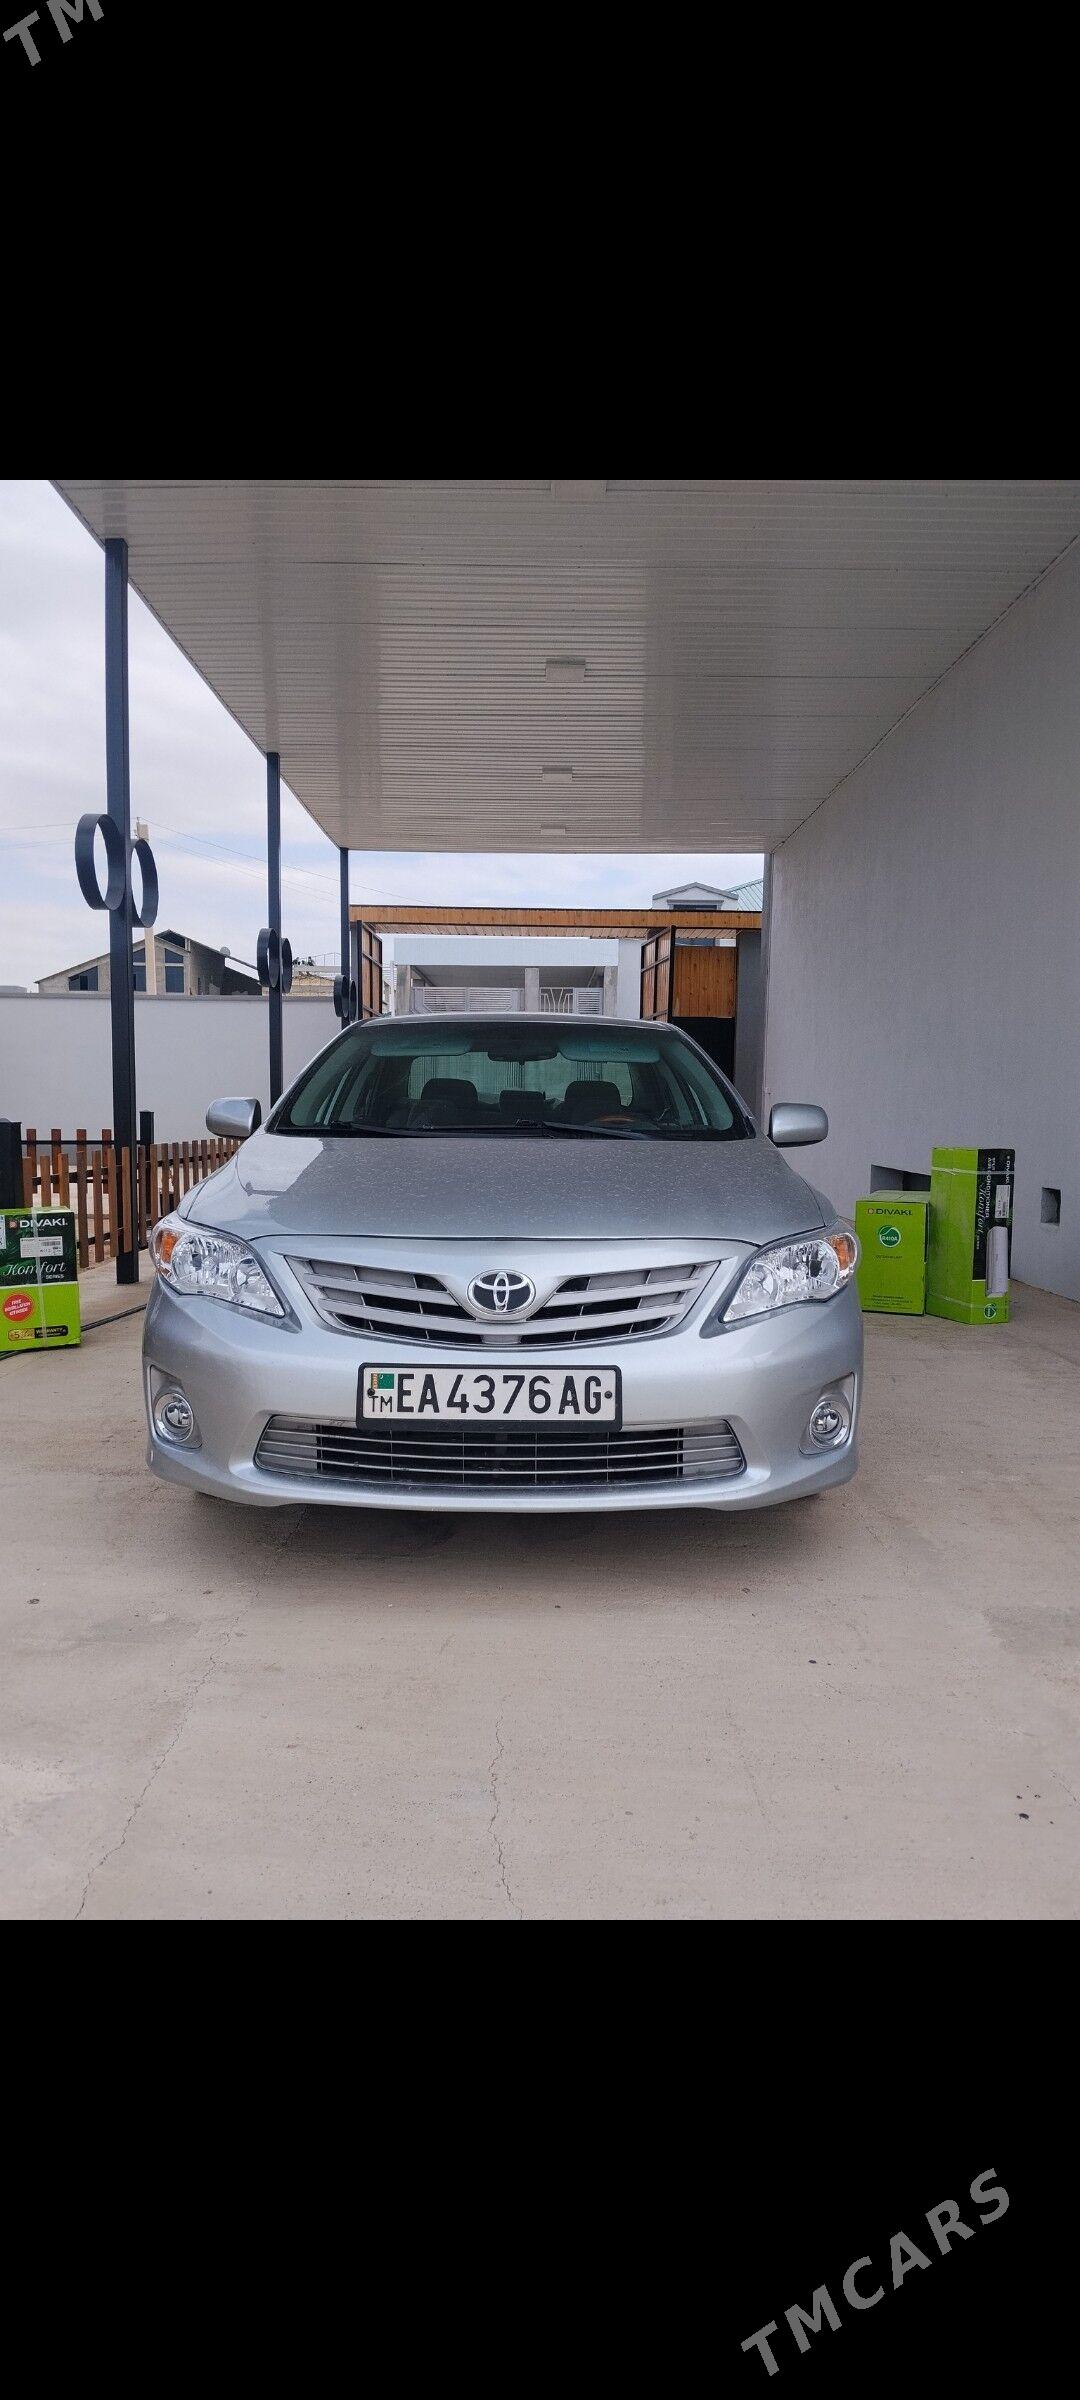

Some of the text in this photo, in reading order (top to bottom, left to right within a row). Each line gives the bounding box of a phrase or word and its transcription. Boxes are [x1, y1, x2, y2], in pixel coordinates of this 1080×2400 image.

[875, 1208, 913, 1216] DIVAKI
[20, 1218, 67, 1228] DIVAKI
[371, 1373, 602, 1415] TM EA4376AG
